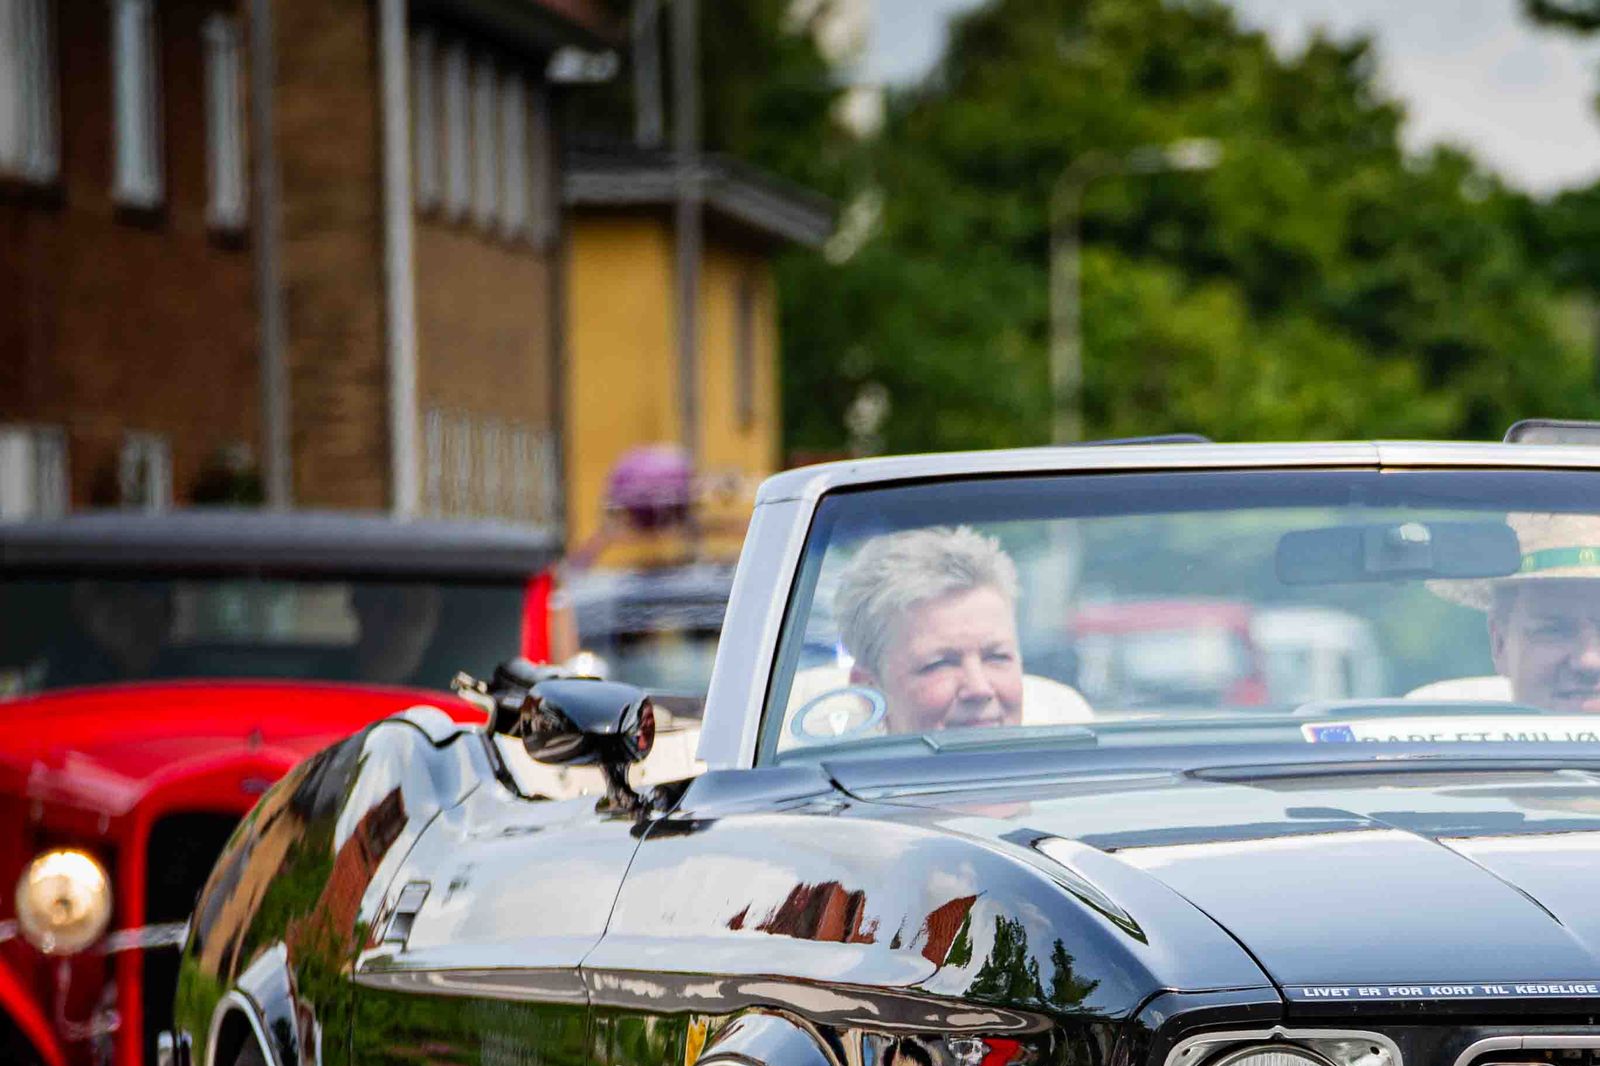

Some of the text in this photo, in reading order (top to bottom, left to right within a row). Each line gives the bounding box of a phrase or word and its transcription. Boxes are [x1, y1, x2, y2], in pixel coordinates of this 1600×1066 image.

[1303, 987, 1350, 997] LIVET
[1358, 986, 1381, 996] ER
[1388, 986, 1423, 996] FOR
[1429, 985, 1475, 995] KORT
[1481, 985, 1509, 994] TIL
[1515, 984, 1598, 994] KEDELIGE
